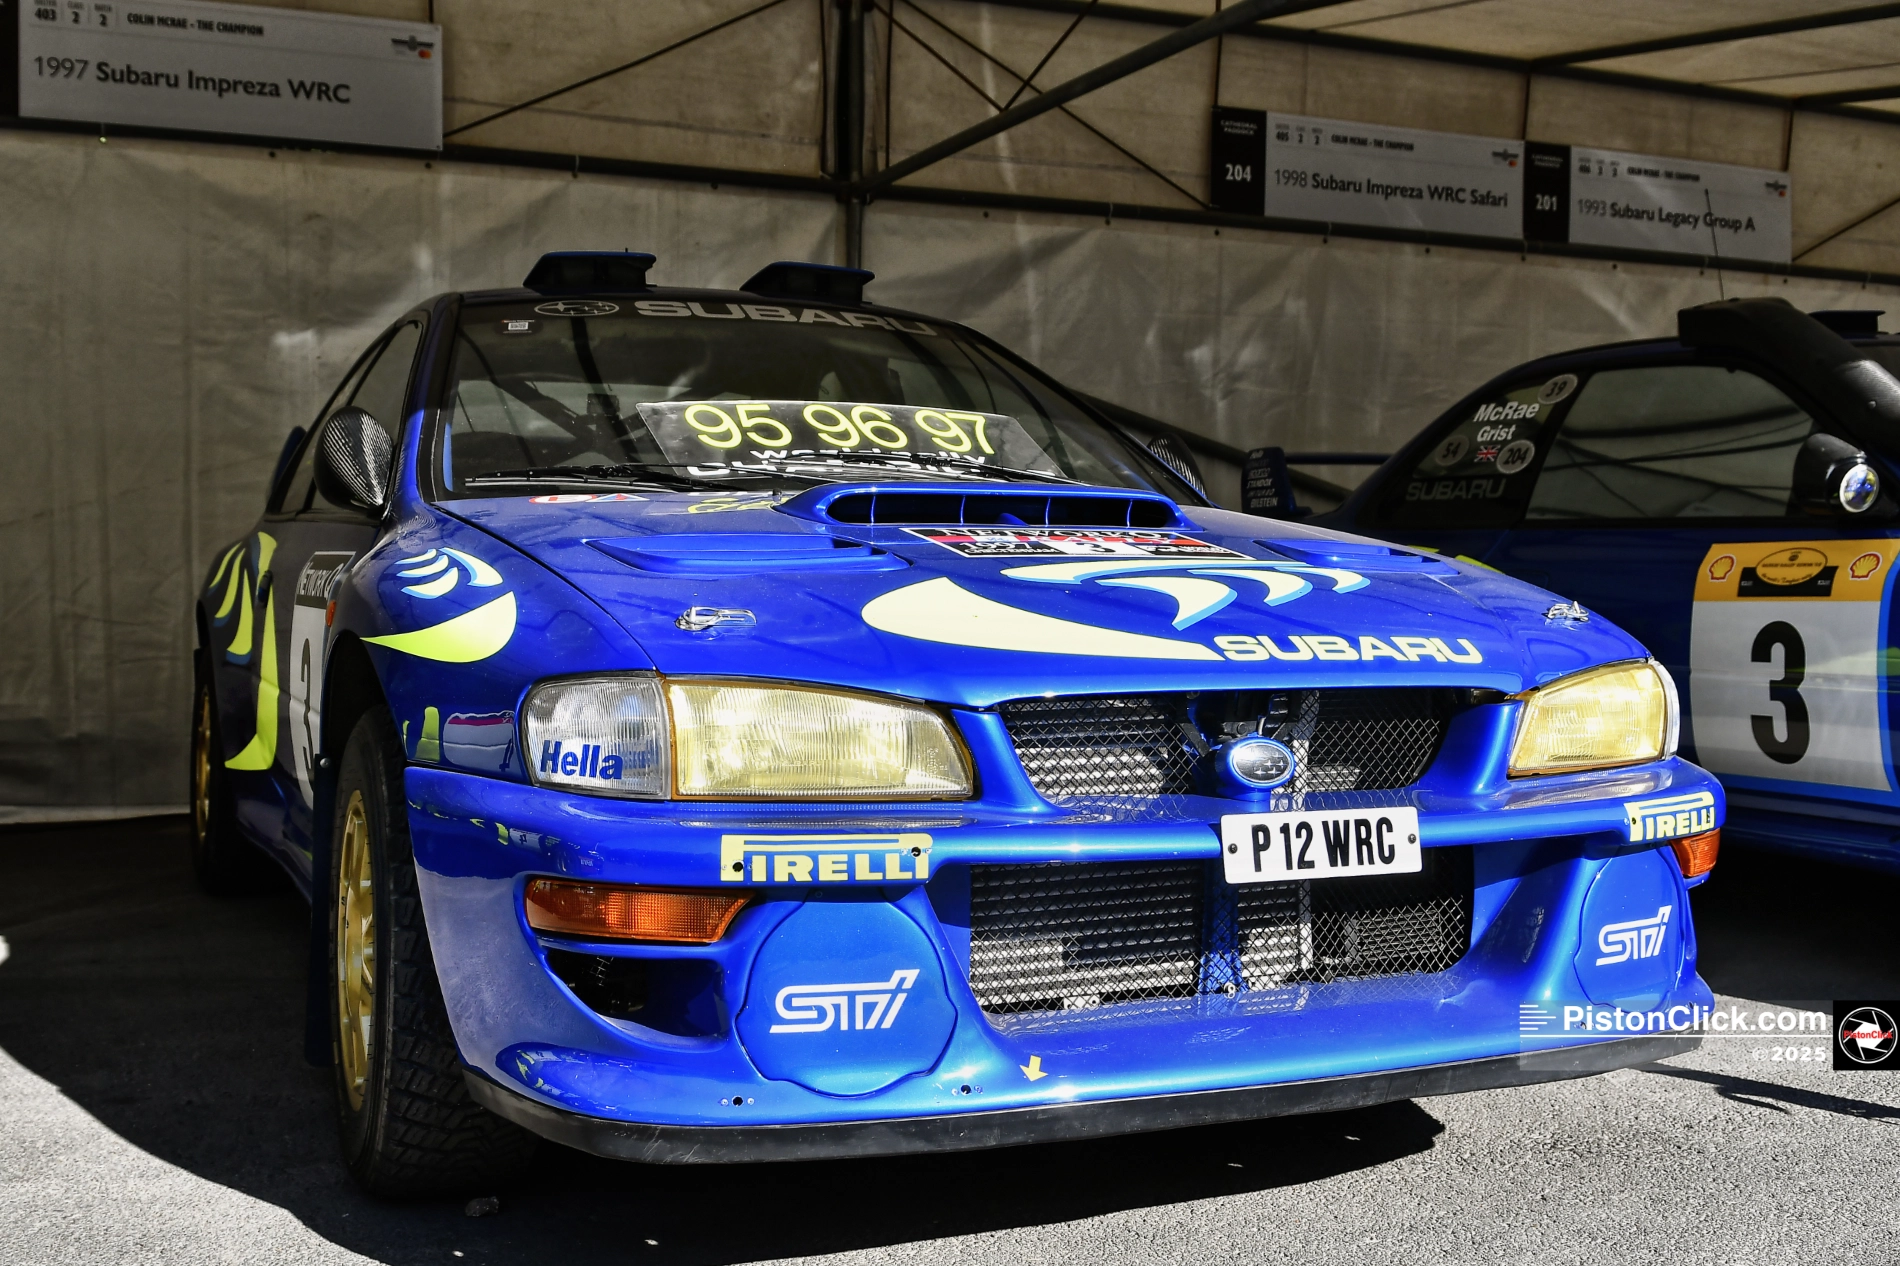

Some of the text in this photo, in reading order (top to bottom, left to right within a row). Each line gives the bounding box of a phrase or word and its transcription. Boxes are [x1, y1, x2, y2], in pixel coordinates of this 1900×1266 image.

[34, 7, 108, 28] 403 2 2
[126, 12, 154, 25] COLIN
[156, 15, 188, 29] MCRAE
[196, 18, 215, 31] THE
[216, 21, 264, 36] CHAMPION
[33, 55, 351, 104] 1997 Subaru Impreza WRC
[1225, 163, 1252, 182] 204
[1273, 168, 1508, 208] 1998 Subaru Impreza WRC Safari
[1535, 193, 1558, 212] 201
[1577, 198, 1756, 233] 1993 Subaru Legacy Group A
[634, 300, 938, 336] SUBARU
[1543, 378, 1568, 398] 39
[1473, 401, 1540, 423] McRae
[684, 403, 996, 455] 95 96 97
[1476, 424, 1516, 443] Grist
[1441, 441, 1461, 460] 54
[1503, 447, 1530, 465] 204
[1405, 478, 1507, 501] SUBARU
[935, 528, 1128, 538] NETWORK
[1027, 536, 1176, 545] RALLY
[959, 541, 1033, 550] 1997
[1075, 543, 1117, 553] 3
[1212, 634, 1484, 665] SUBARU
[300, 637, 314, 771] 3
[1749, 620, 1811, 765] 3
[540, 739, 624, 780] Hella
[1624, 791, 1715, 842] PIRELLI
[1321, 816, 1397, 868] WRC
[720, 833, 934, 882] PIRELLI
